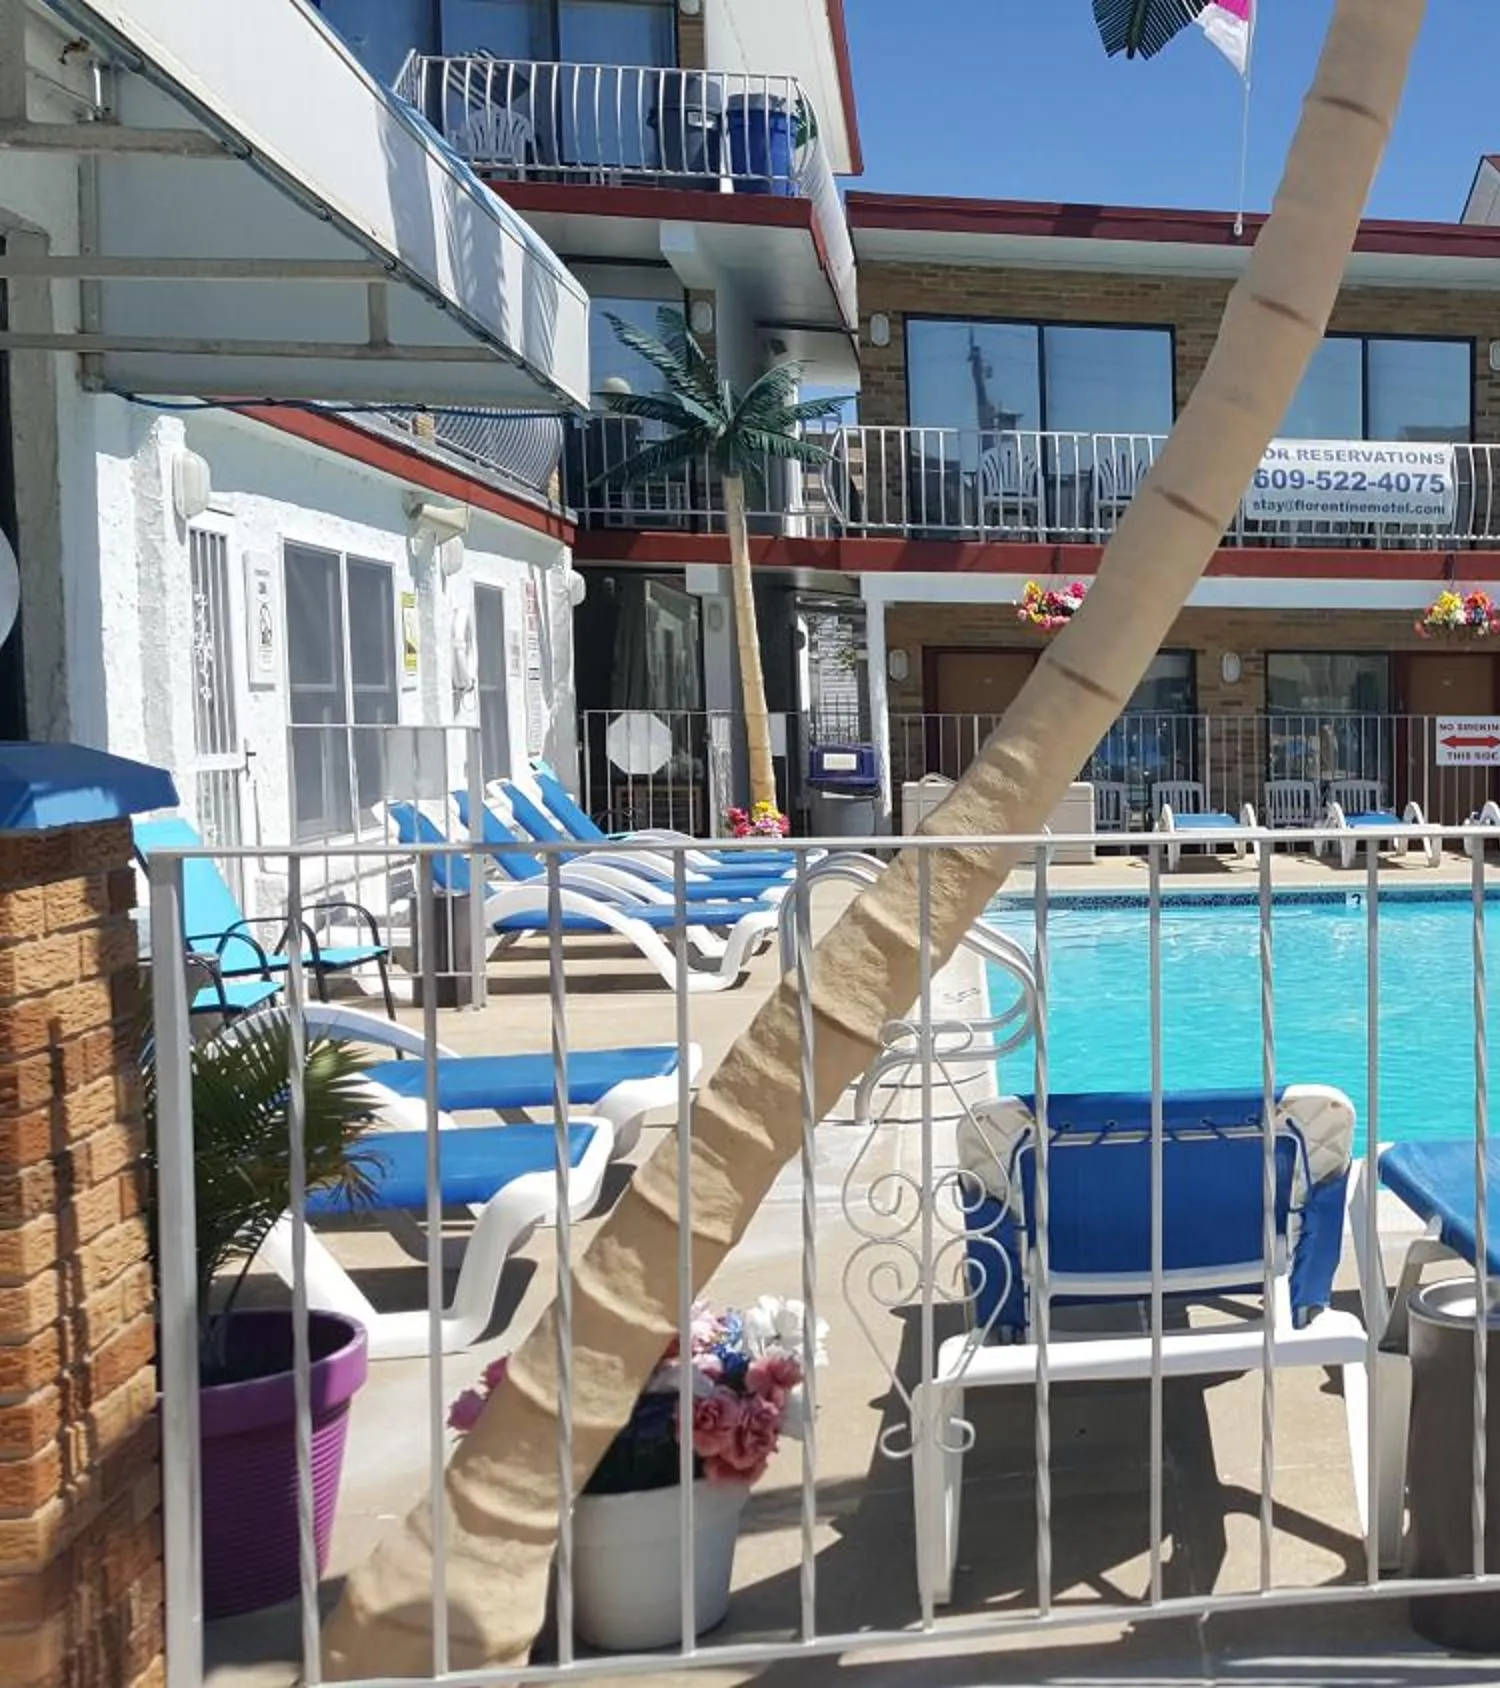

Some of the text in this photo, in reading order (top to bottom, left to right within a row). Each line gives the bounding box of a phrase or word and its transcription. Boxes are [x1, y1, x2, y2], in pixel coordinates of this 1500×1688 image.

[1263, 447, 1445, 465] OR RESERVATIONS
[1254, 468, 1445, 494] 609-522-4075
[1253, 497, 1445, 515] stay@florentinemotel.com
[1439, 723, 1455, 731] NO
[1446, 751, 1499, 761] THIS SIDE
